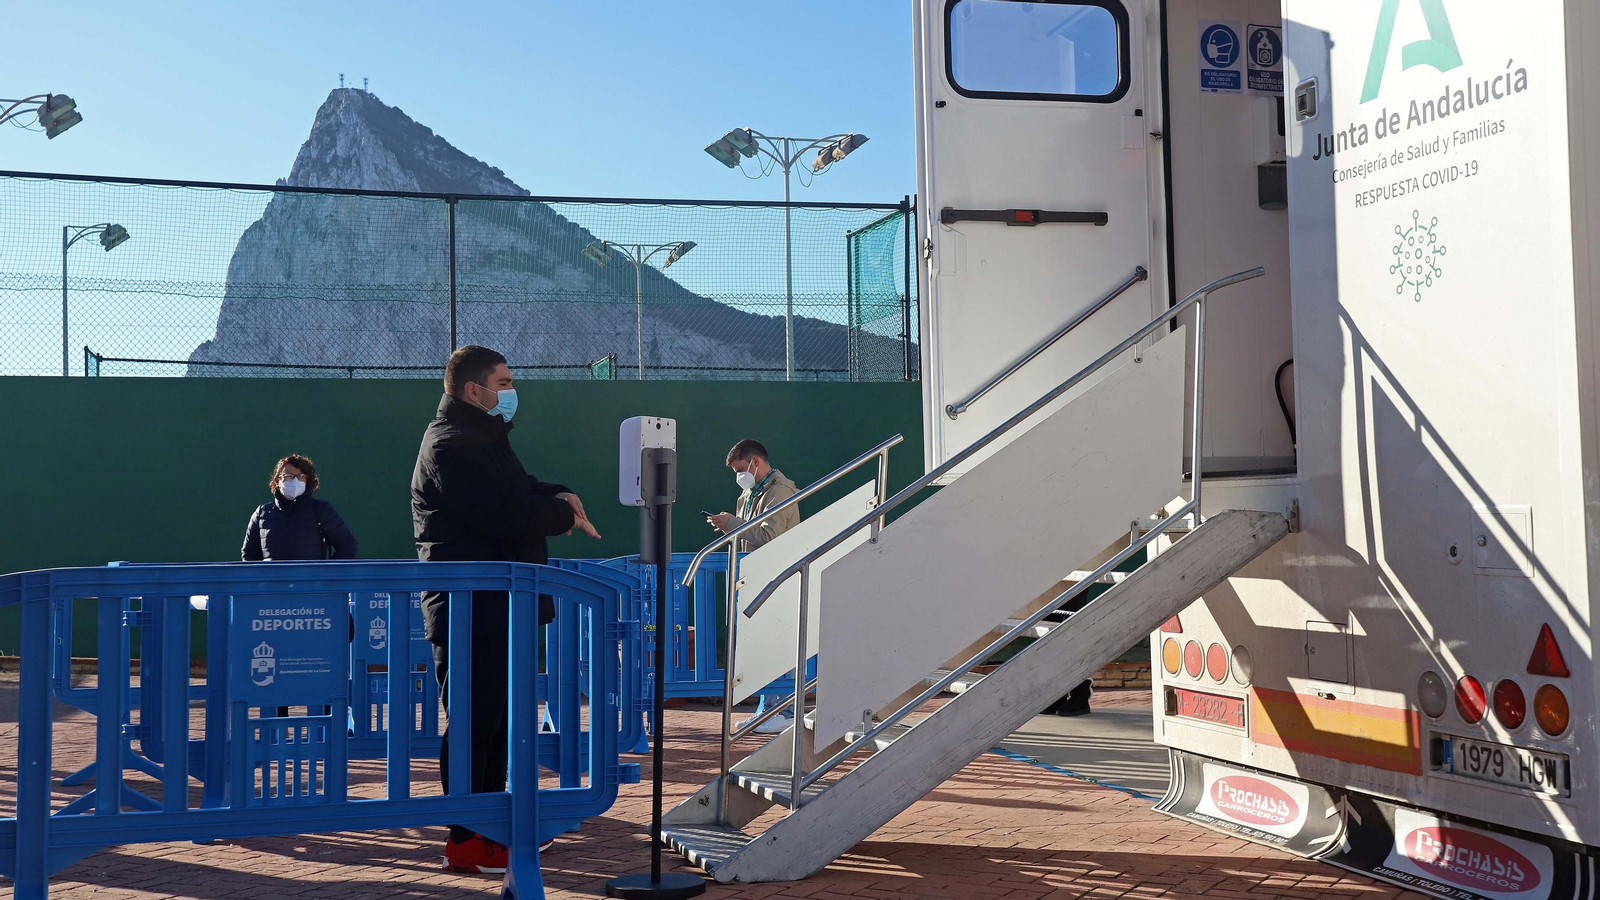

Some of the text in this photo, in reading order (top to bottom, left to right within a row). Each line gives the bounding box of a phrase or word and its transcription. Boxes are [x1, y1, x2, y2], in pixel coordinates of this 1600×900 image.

[1249, 76, 1277, 84] OBLIGATORIO
[1312, 58, 1528, 161] Junta de Andalucía
[1332, 119, 1506, 184] Consejería de Salud y Familias
[1355, 159, 1479, 208] RESPUESTA COVID-19
[252, 618, 332, 631] DEPORTES
[259, 607, 312, 616] DELEGACIÓN
[1460, 743, 1557, 788] 1979 HGW
[1217, 801, 1286, 823] CARROCEROS
[1372, 866, 1413, 882] CAMUÑAS
[1416, 879, 1451, 893] TOLEDO
[1414, 855, 1520, 891] CARROCEROS
